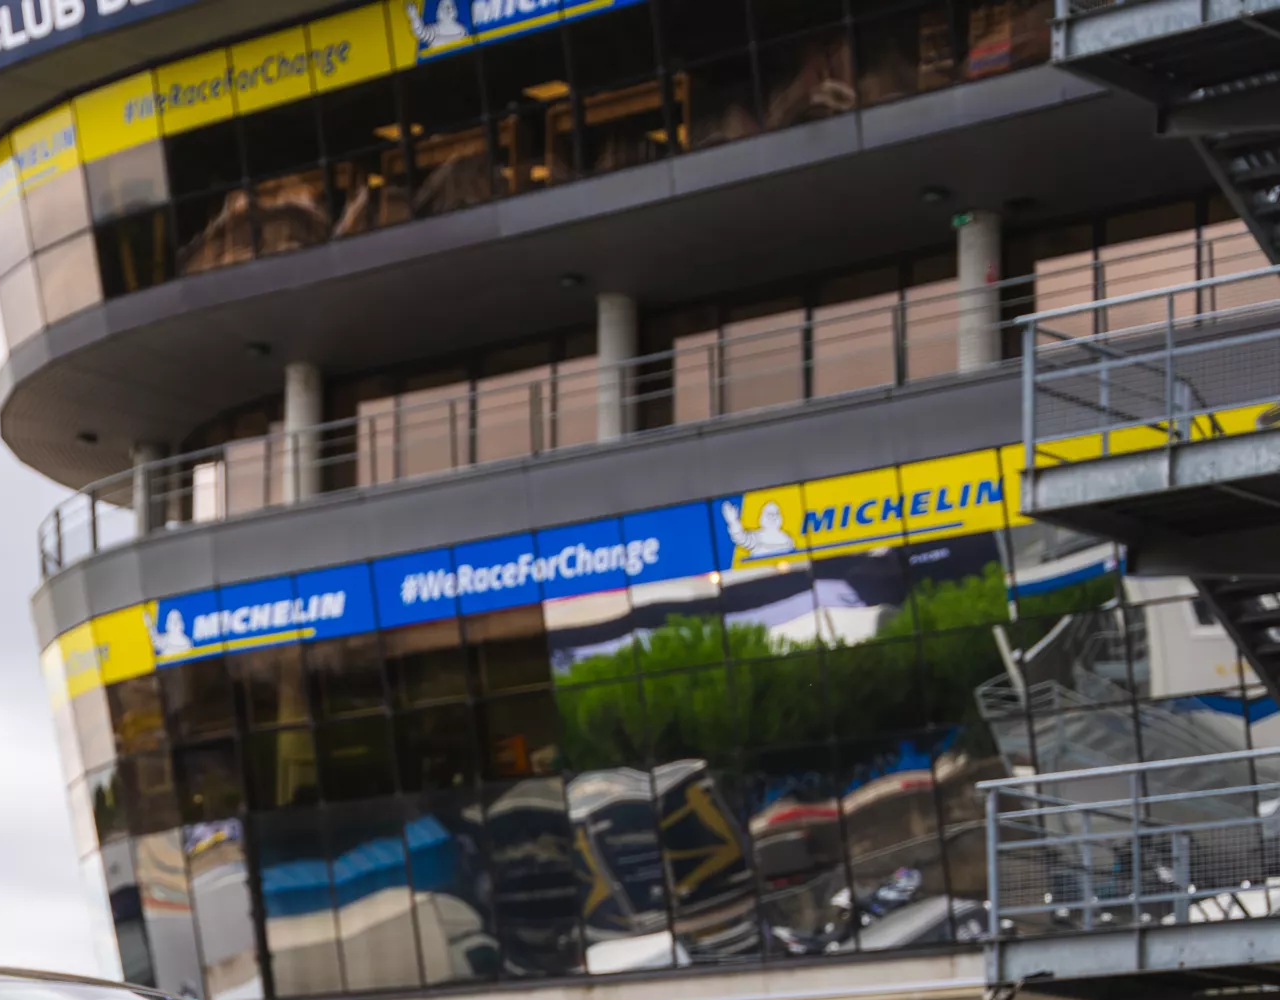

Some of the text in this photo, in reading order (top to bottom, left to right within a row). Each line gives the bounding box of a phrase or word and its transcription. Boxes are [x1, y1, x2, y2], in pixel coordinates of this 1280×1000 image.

[801, 477, 1004, 534] MICHELIN
[401, 537, 659, 605] #WeRaceForChange
[192, 590, 346, 641] MICHELIN
